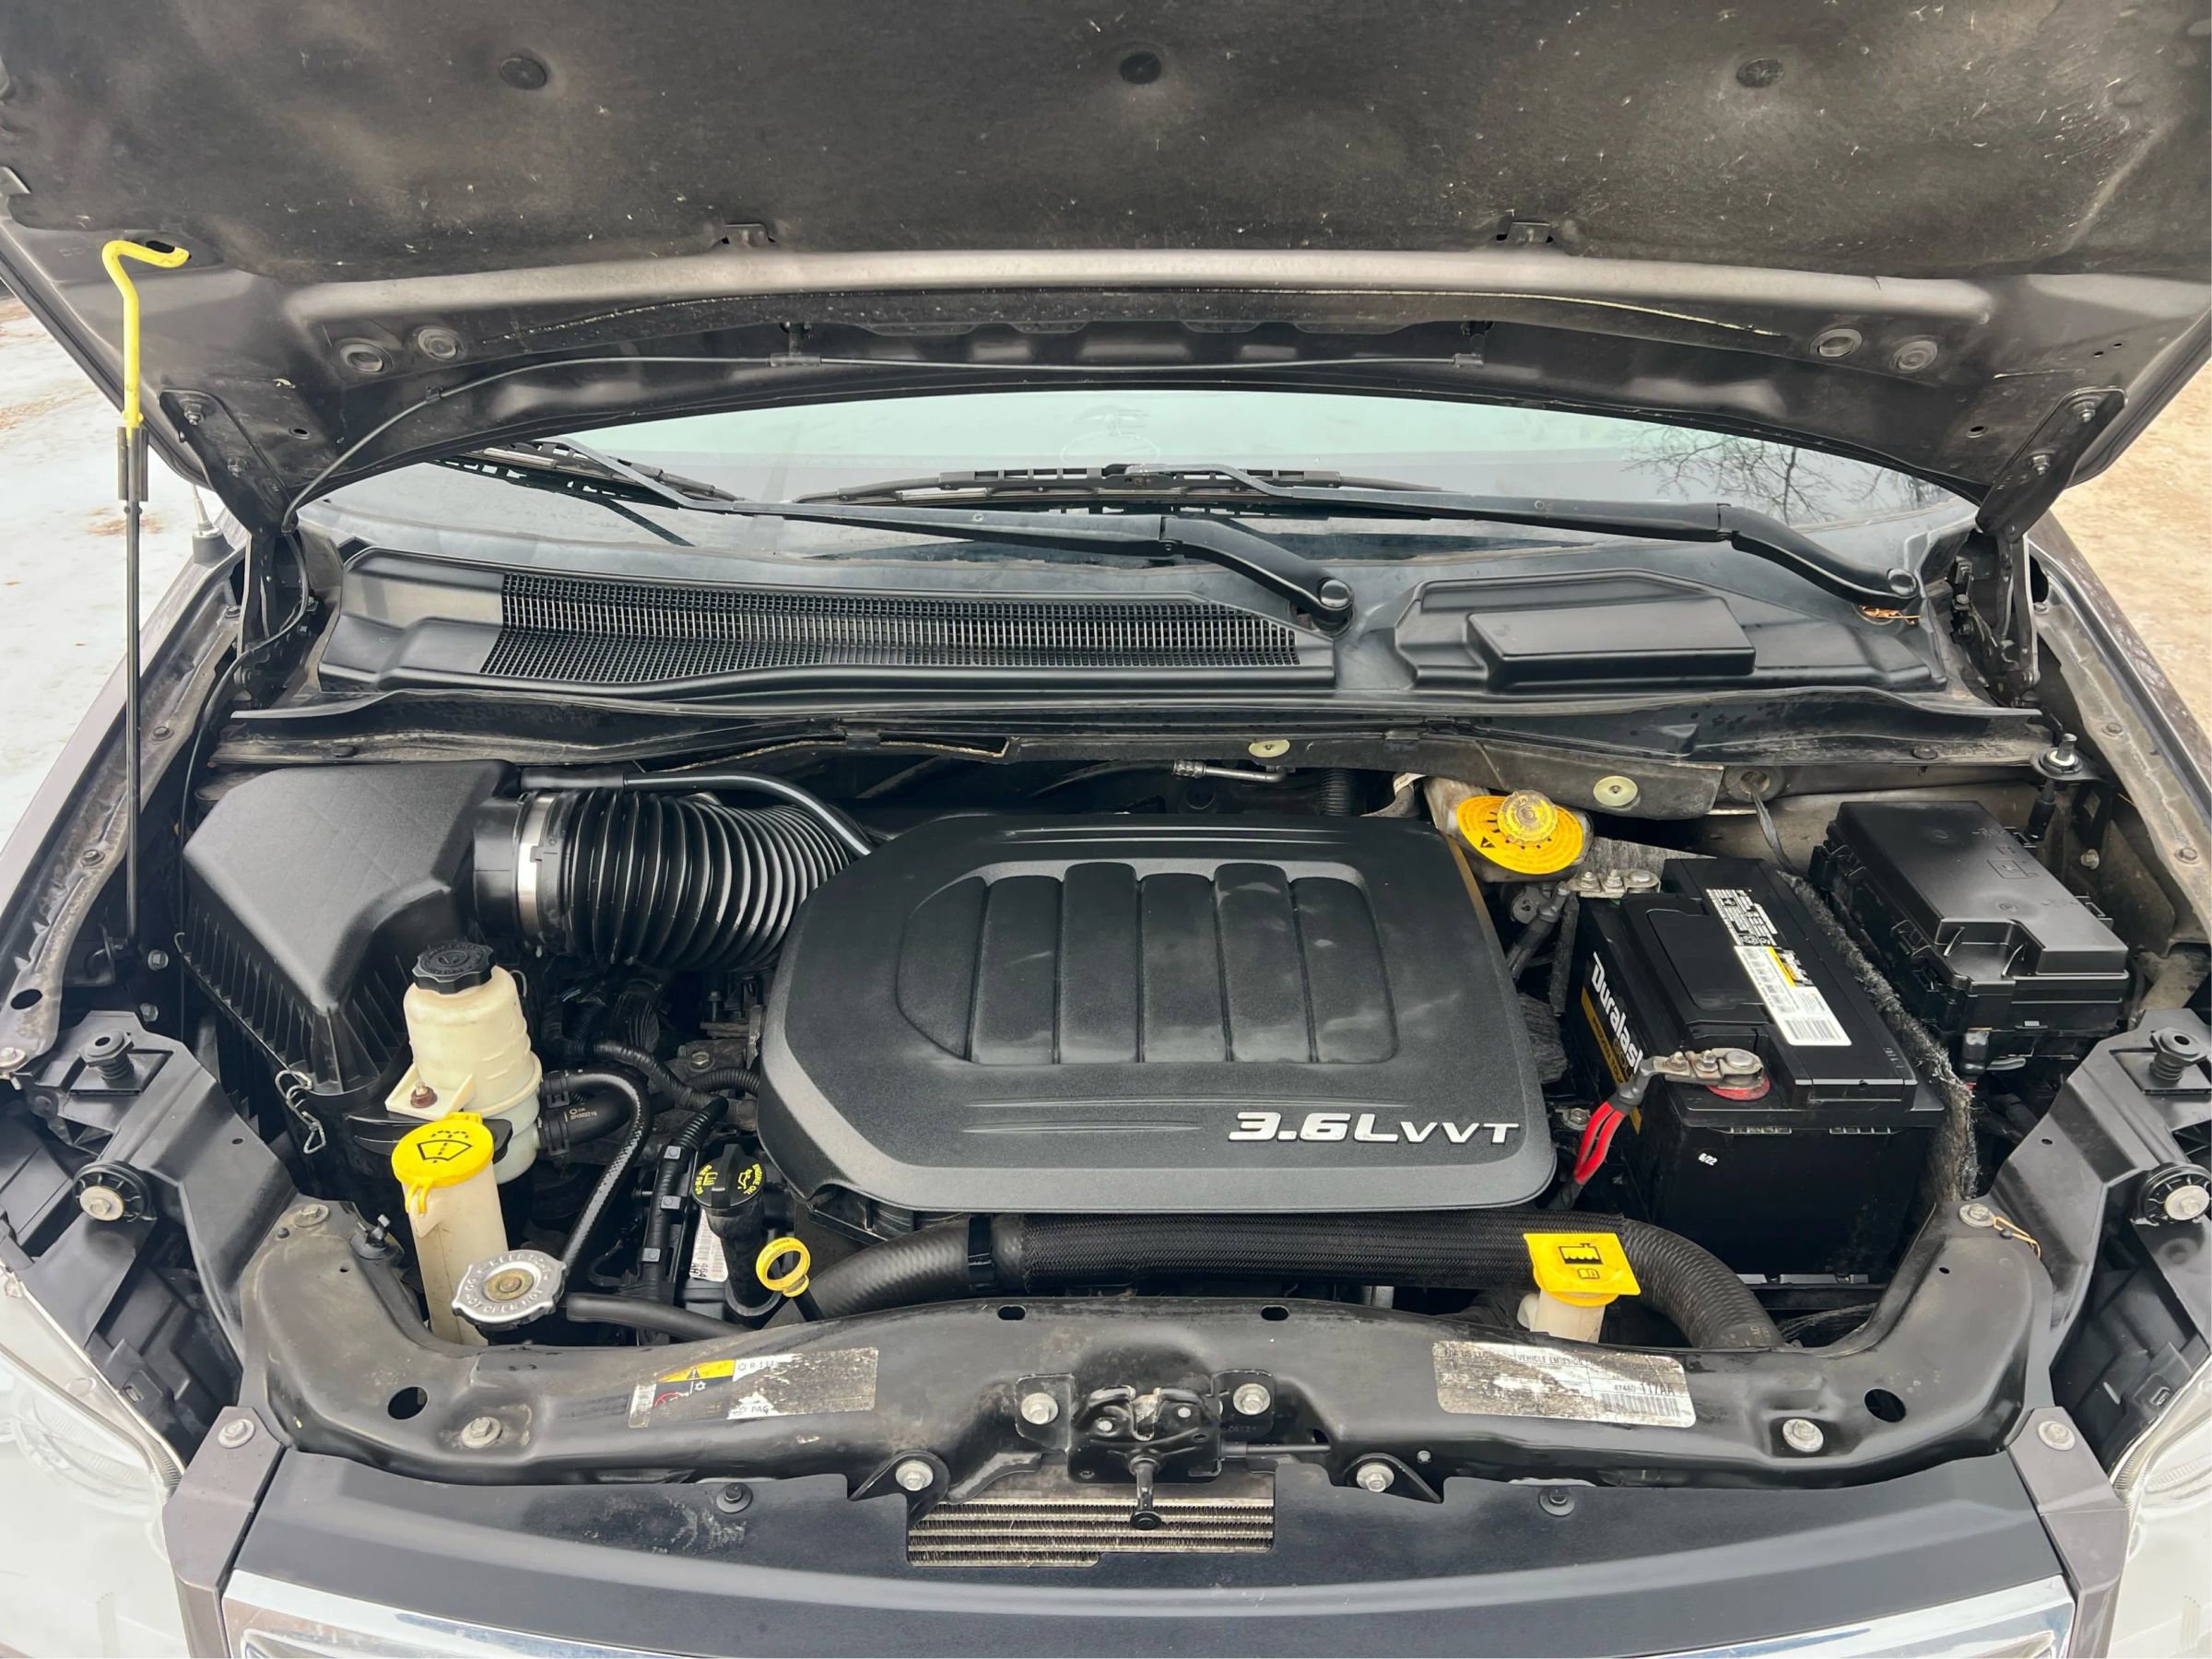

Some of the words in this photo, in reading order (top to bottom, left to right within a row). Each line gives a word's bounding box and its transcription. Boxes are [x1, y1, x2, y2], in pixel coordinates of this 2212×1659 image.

[1698, 1152, 1718, 1166] 6/22
[752, 1163, 763, 1186] ENGINE
[743, 1185, 757, 1195] OIL
[1518, 1354, 1547, 1364] VEHICLE
